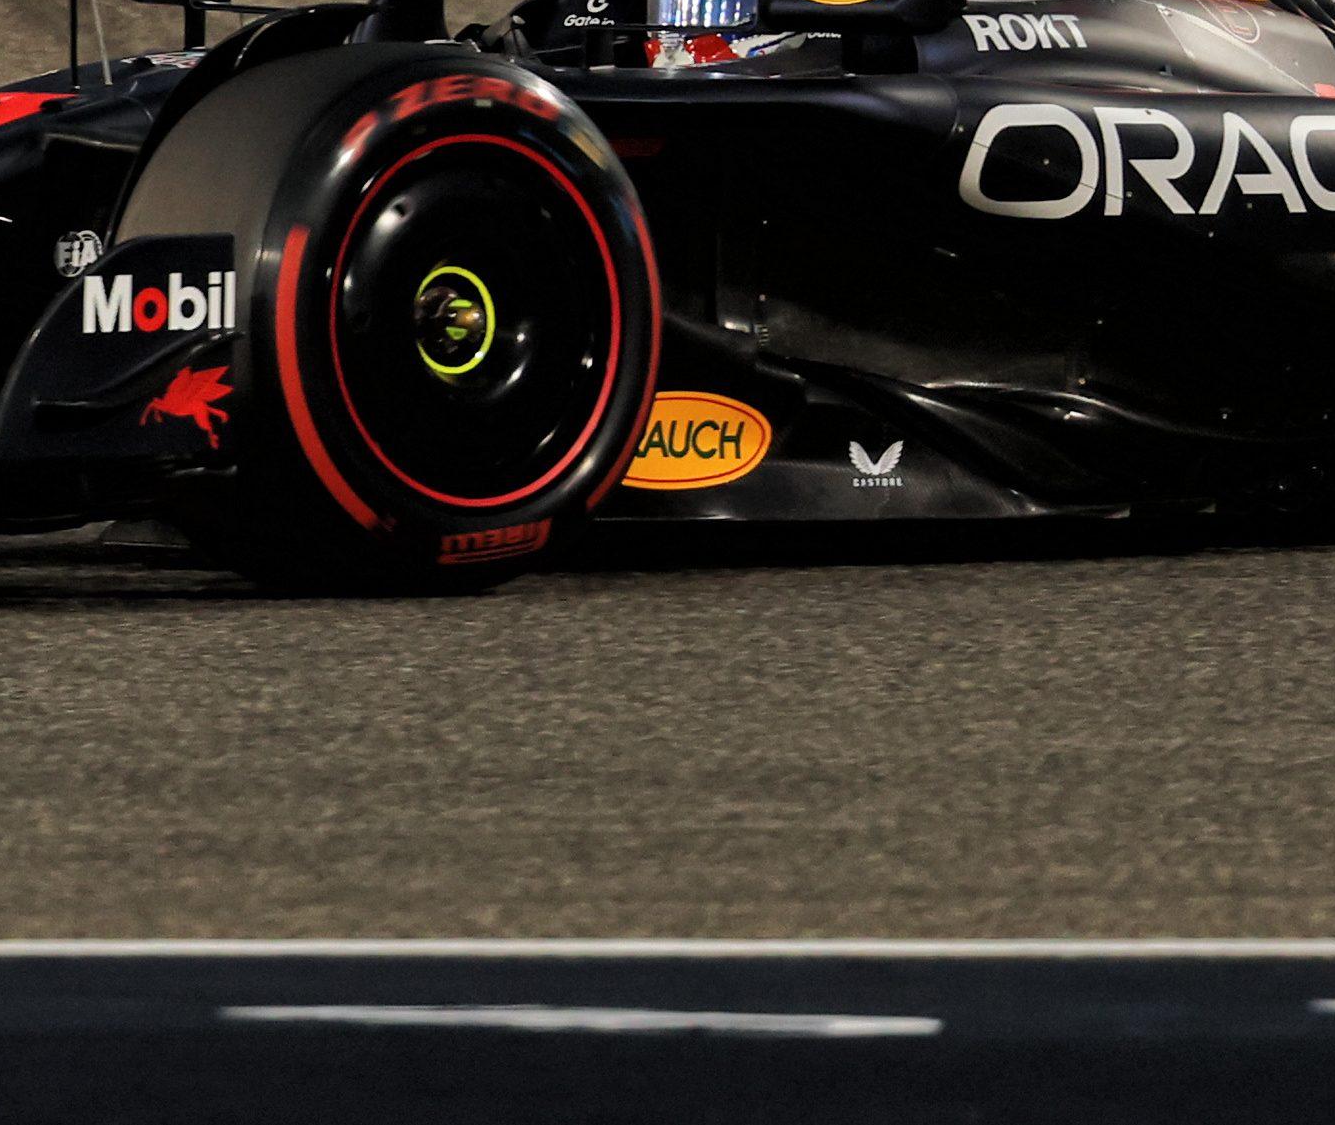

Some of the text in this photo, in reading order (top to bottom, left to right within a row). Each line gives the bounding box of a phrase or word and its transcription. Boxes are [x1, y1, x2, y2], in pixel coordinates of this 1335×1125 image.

[962, 13, 1088, 52] ROKT
[82, 271, 237, 333] Mobil
[634, 419, 744, 460] AUCH
